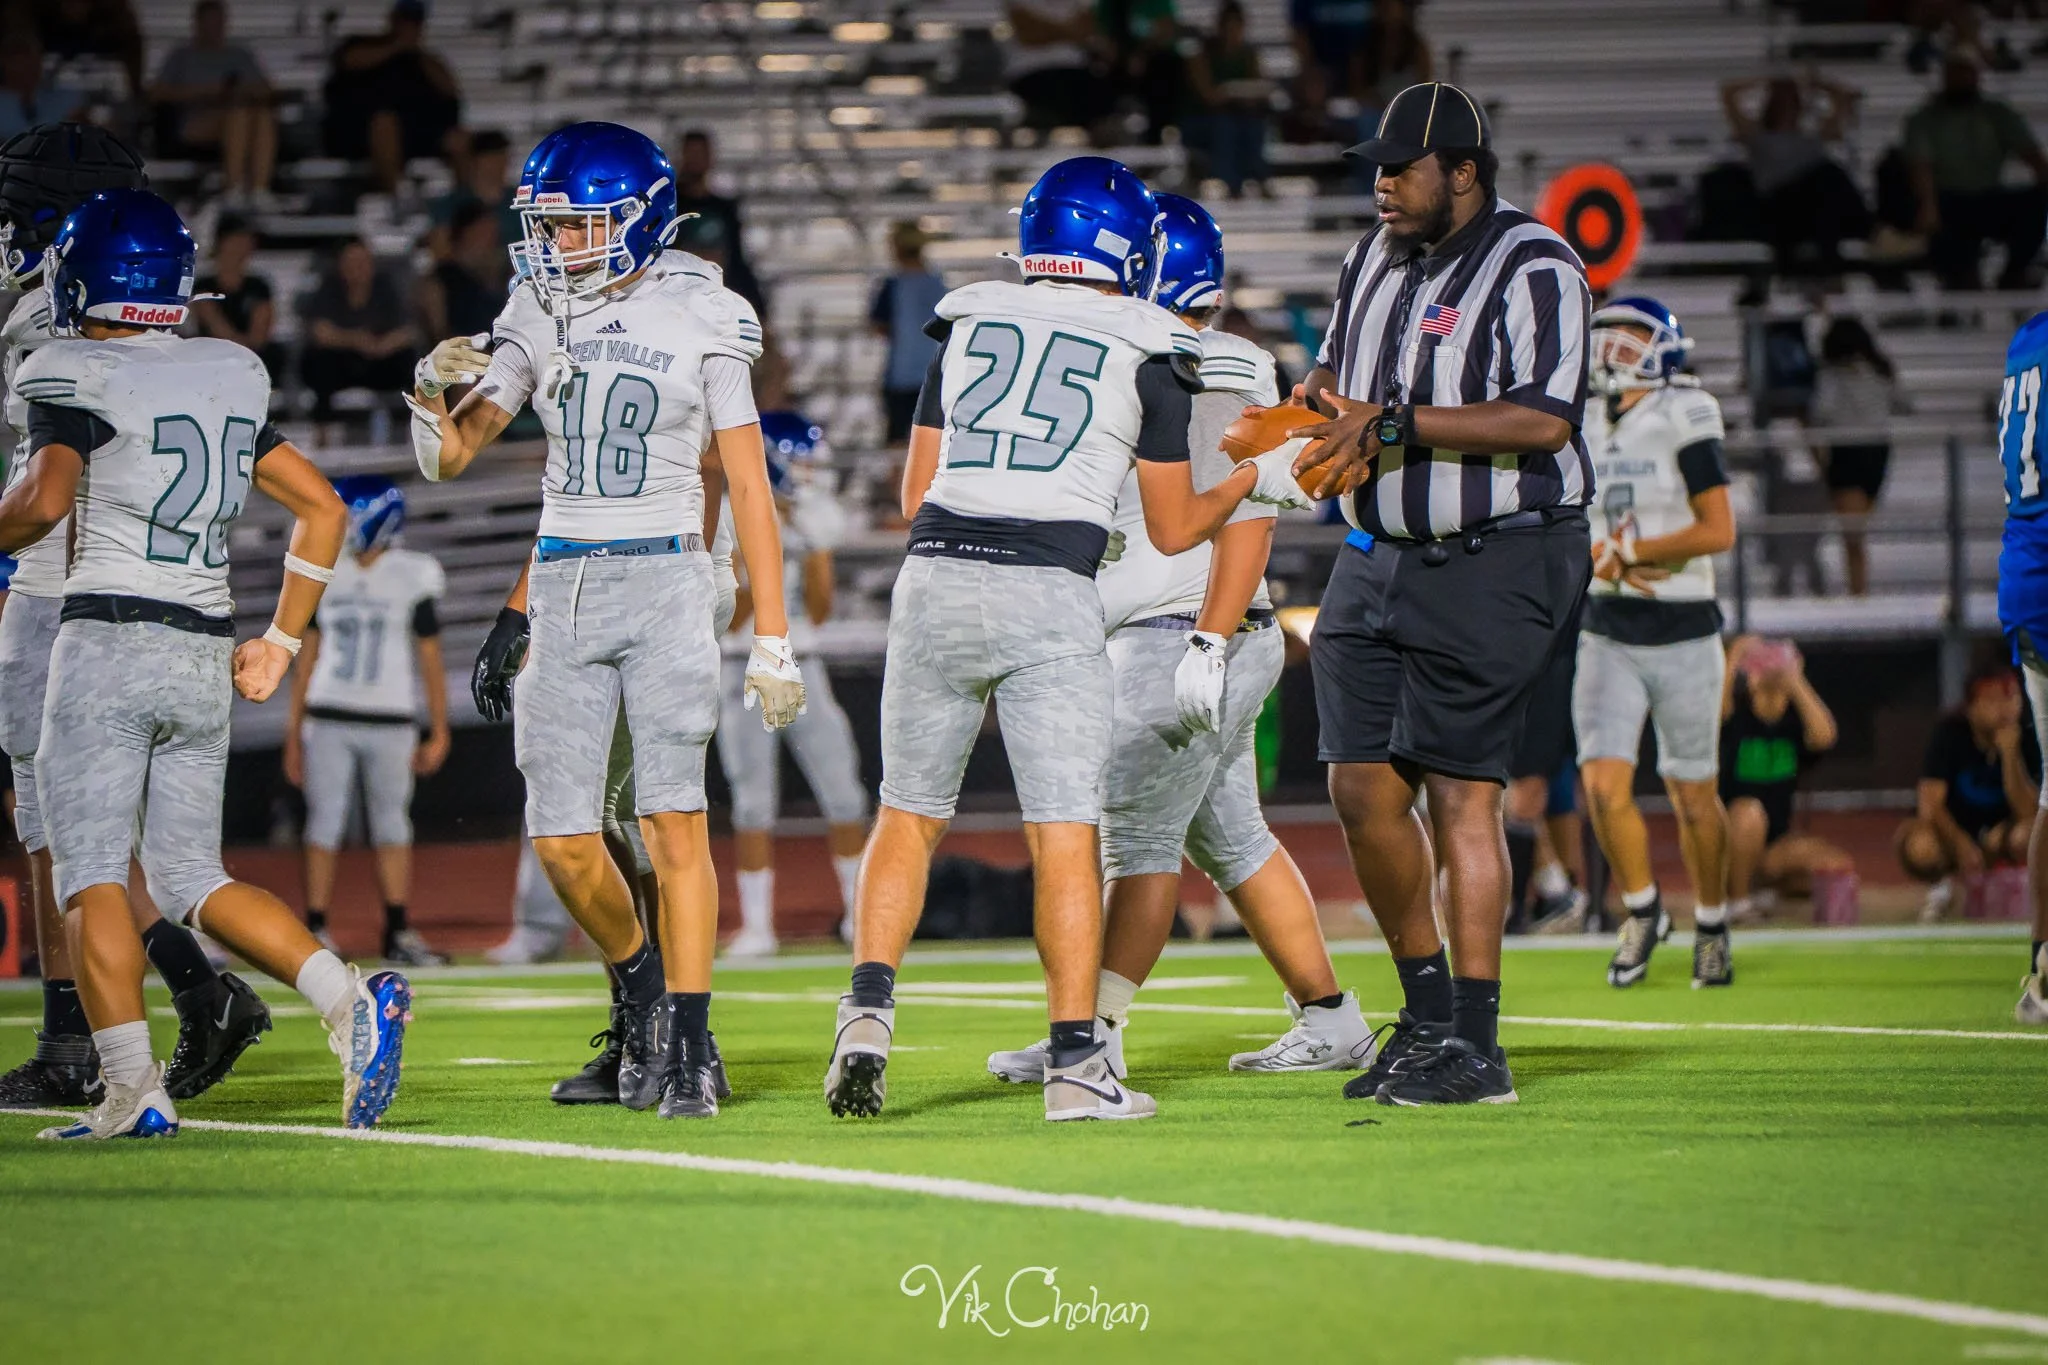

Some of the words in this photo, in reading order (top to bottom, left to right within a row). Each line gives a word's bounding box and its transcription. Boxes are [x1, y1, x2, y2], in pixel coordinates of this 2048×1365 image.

[1024, 258, 1084, 275] Riddell
[120, 305, 183, 323] Riddell
[555, 319, 565, 347] NXTRND
[571, 339, 603, 362] EEN
[606, 339, 675, 373] VALLEY
[947, 321, 1110, 472] 25
[557, 371, 660, 498] 18
[146, 413, 257, 569] 26
